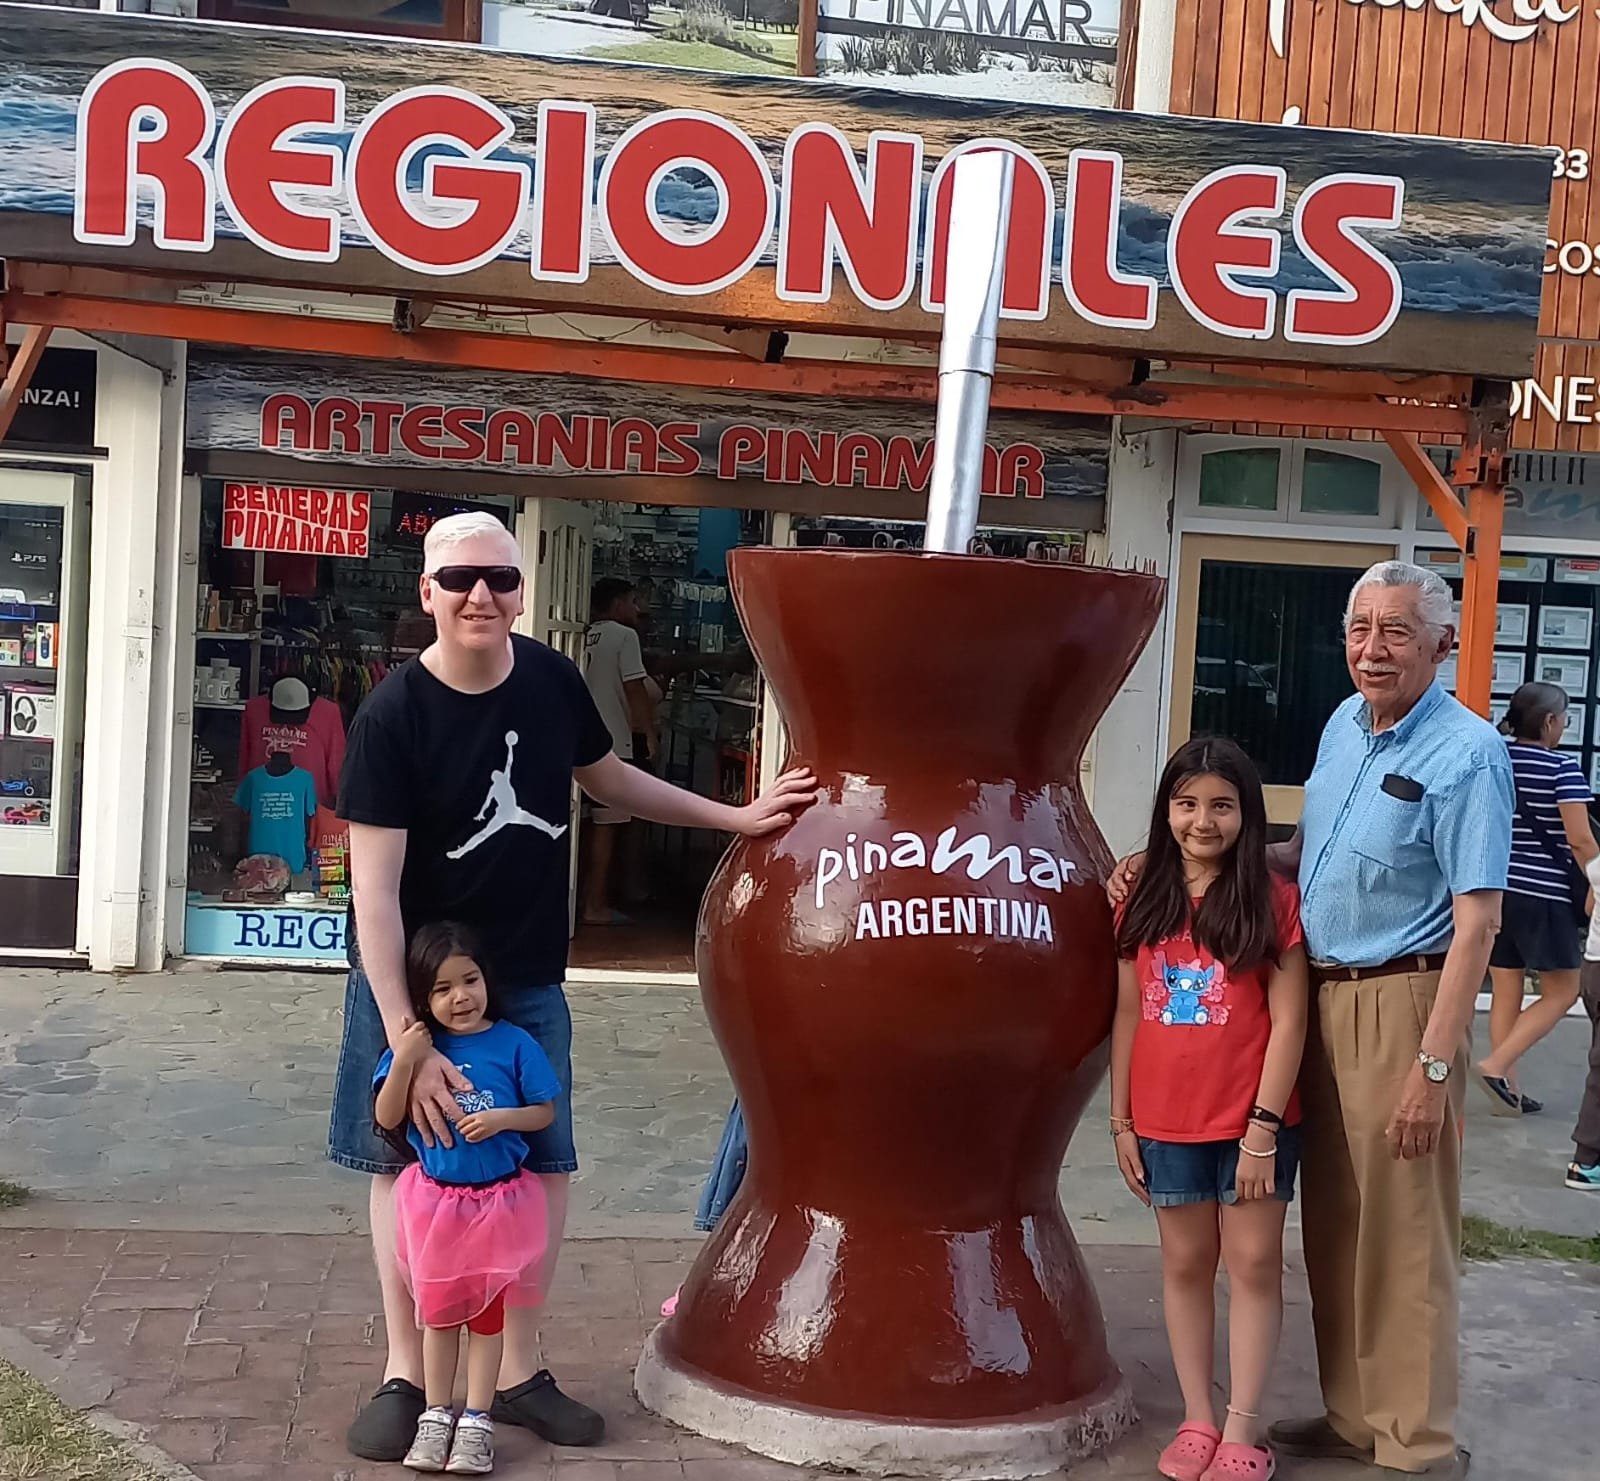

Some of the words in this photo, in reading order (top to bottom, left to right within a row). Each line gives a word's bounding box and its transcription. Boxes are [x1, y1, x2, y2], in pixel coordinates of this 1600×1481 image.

[19, 388, 80, 409] NZA!
[259, 392, 702, 476] ARTESANIAS
[223, 483, 369, 532] REMERAS
[222, 509, 367, 556] PINAMAR
[813, 825, 1077, 909] pinamar
[234, 913, 347, 953] REG
[854, 897, 1054, 942] ARGENTINA
